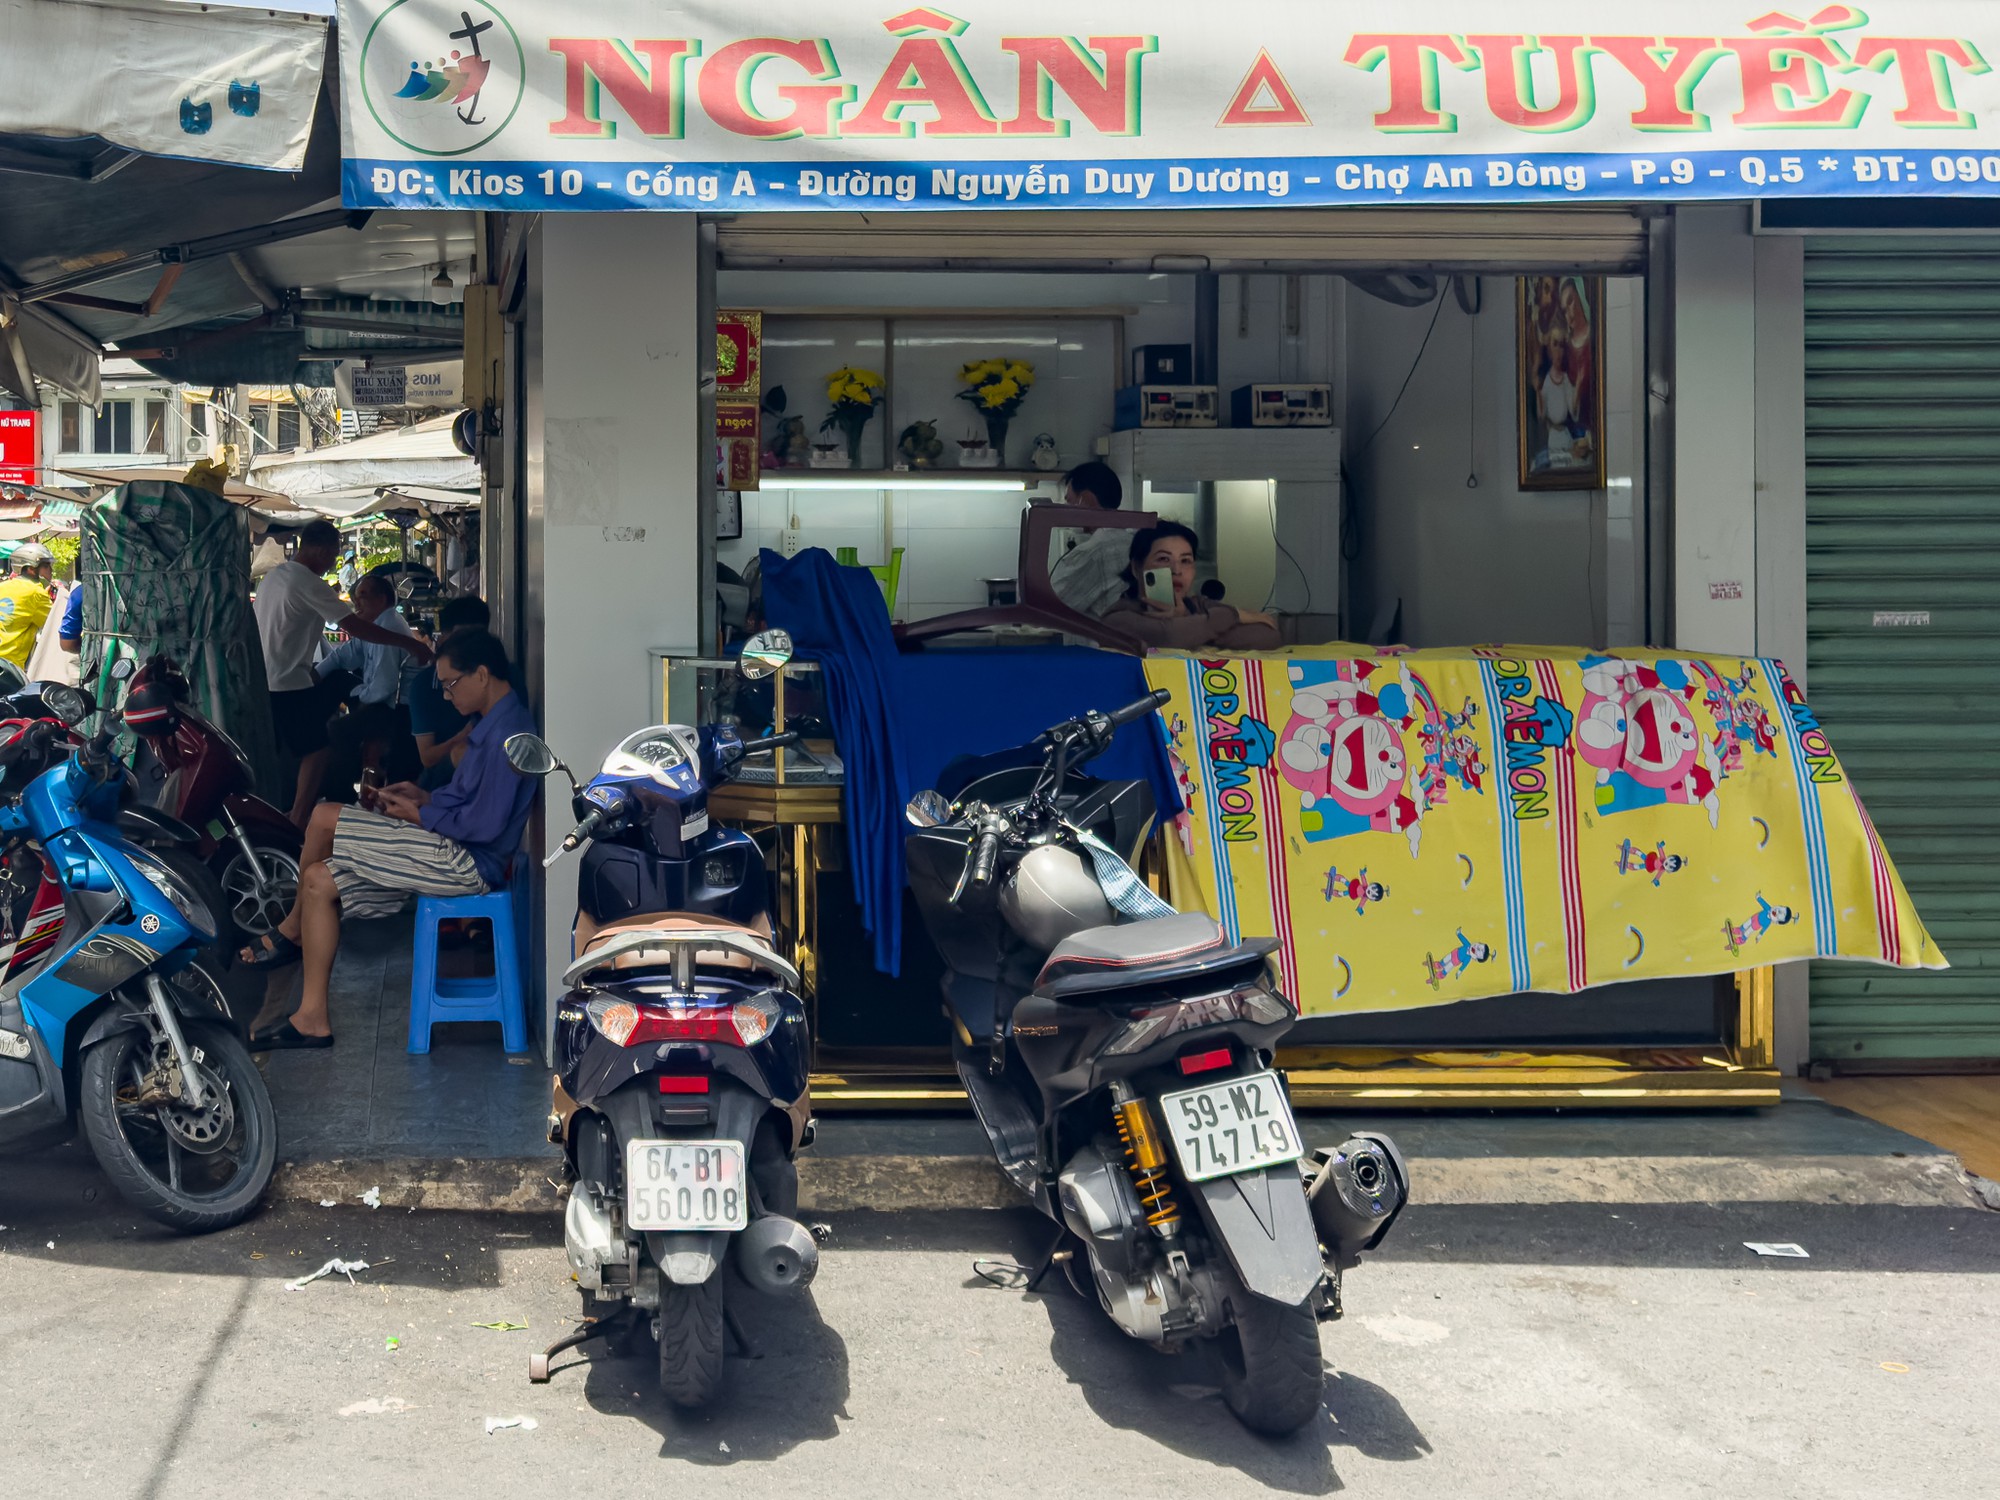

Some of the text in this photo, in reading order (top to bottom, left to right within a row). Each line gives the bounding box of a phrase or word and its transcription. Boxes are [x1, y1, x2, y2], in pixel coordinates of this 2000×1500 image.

[547, 4, 1993, 140] NGÂN TUYẾT
[371, 168, 435, 195] ĐC:
[450, 169, 524, 196] Kios
[538, 169, 583, 196] 10
[626, 164, 718, 201] Cổng
[731, 170, 757, 197] A
[798, 169, 916, 202] Đường
[932, 164, 1070, 200] Nguyễn
[1085, 167, 1155, 199] Duy
[1169, 166, 1290, 197] Dương
[1336, 163, 1410, 195] Chợ
[1424, 162, 1473, 188] An
[1486, 159, 1587, 191] Đông
[1630, 157, 1695, 185] P.9
[1739, 156, 1805, 186] Q.5
[1853, 155, 1919, 182] ĐT:
[1931, 155, 2000, 183] 090
[1491, 659, 1549, 820] ORAEMON
[1179, 1083, 1269, 1131] 59-M2
[646, 1147, 722, 1182] 64-B1
[1185, 1119, 1290, 1172] 747.49
[636, 1187, 738, 1222] 560.08
